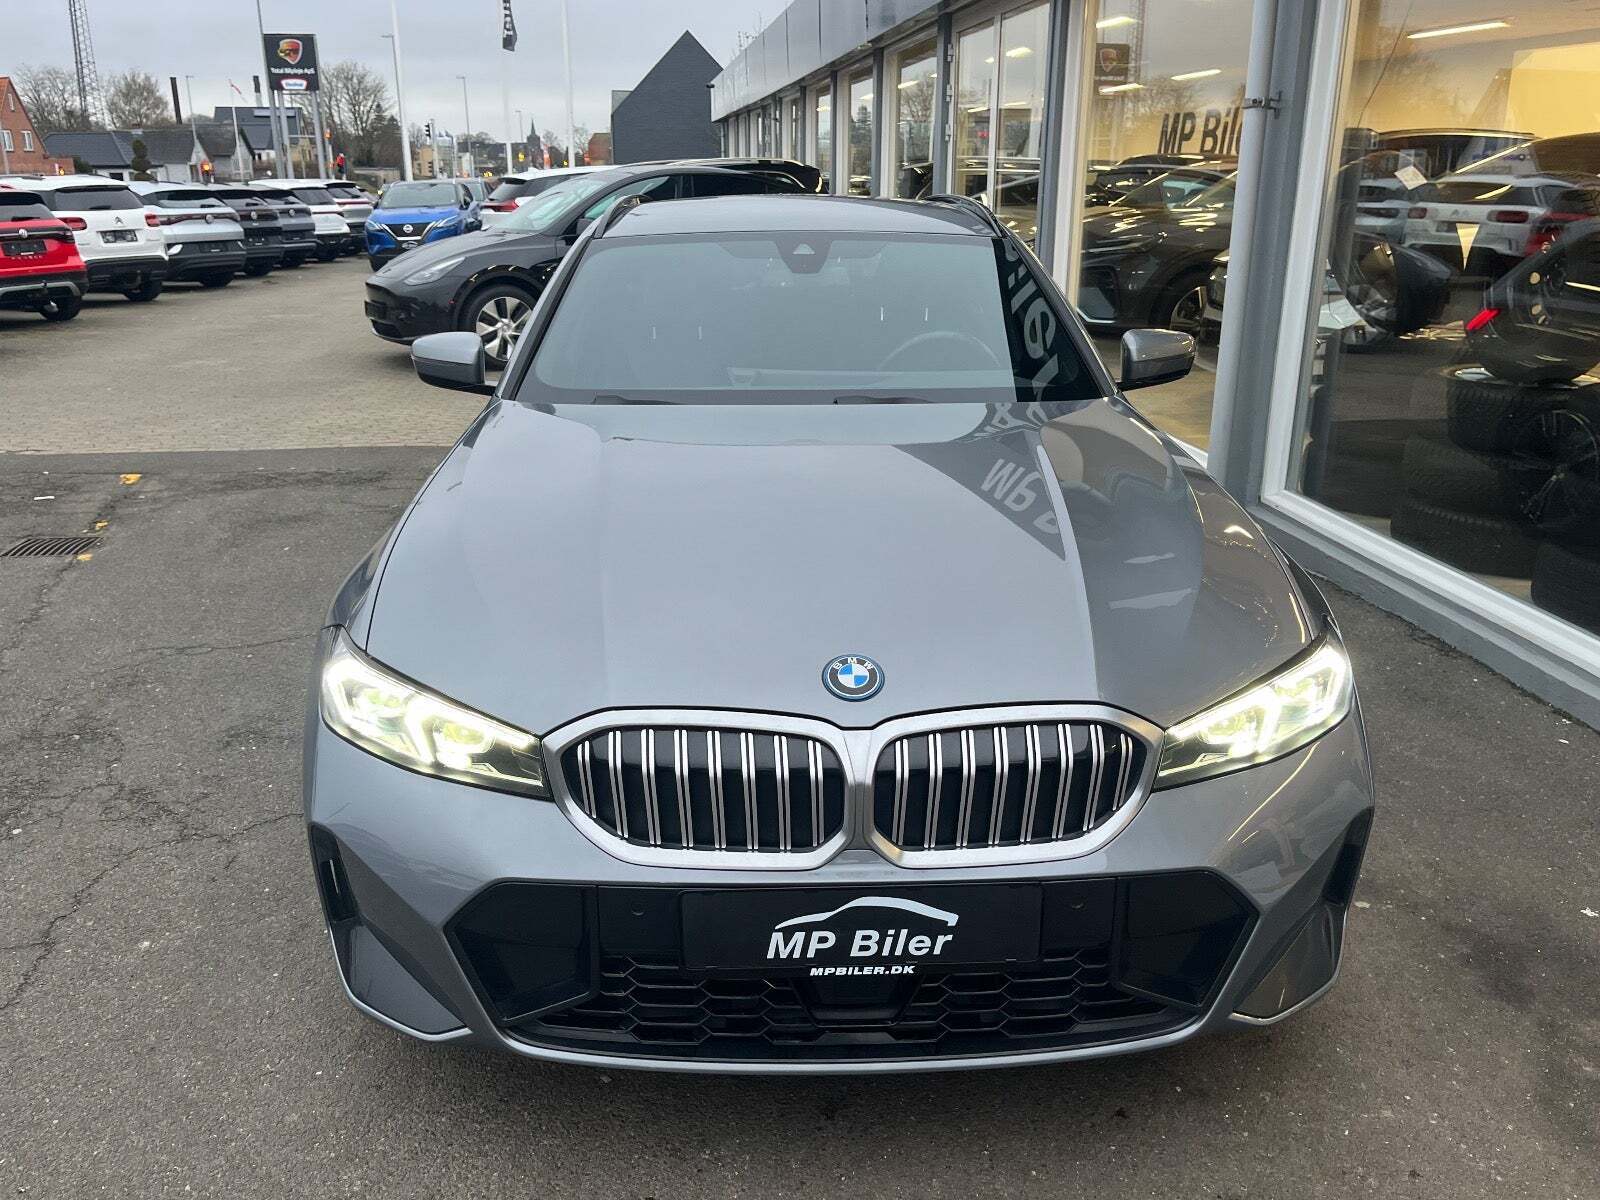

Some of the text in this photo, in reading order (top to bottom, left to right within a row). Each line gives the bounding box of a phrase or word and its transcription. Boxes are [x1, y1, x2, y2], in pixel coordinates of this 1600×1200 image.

[1157, 111, 1196, 154] MP
[832, 656, 874, 670] BMW
[766, 928, 954, 960] MP Biler
[809, 965, 916, 977] MPBILER.DK
